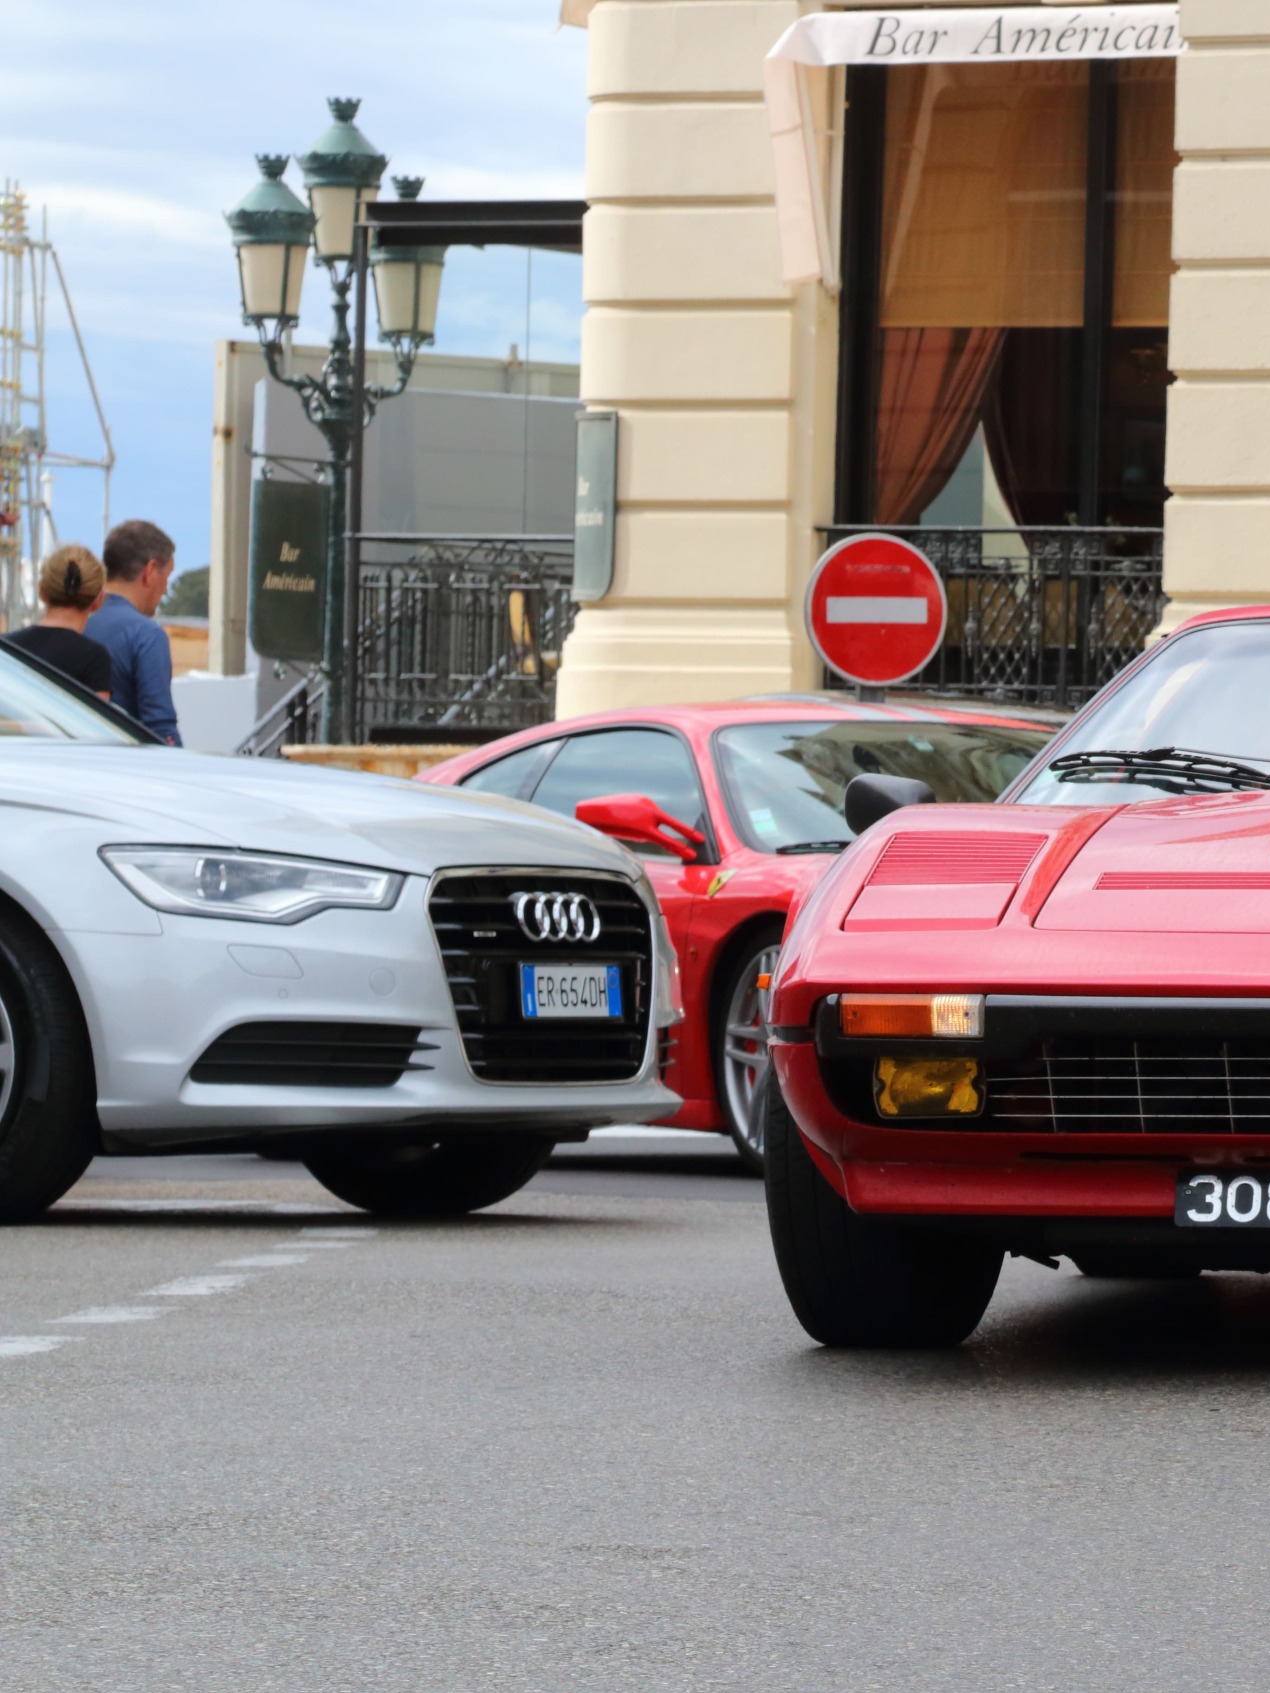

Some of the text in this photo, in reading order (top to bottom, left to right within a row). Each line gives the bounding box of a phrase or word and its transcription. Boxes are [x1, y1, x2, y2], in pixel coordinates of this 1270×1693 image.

[866, 16, 949, 57] Bar
[280, 541, 301, 562] Bar
[262, 569, 316, 592] Américain
